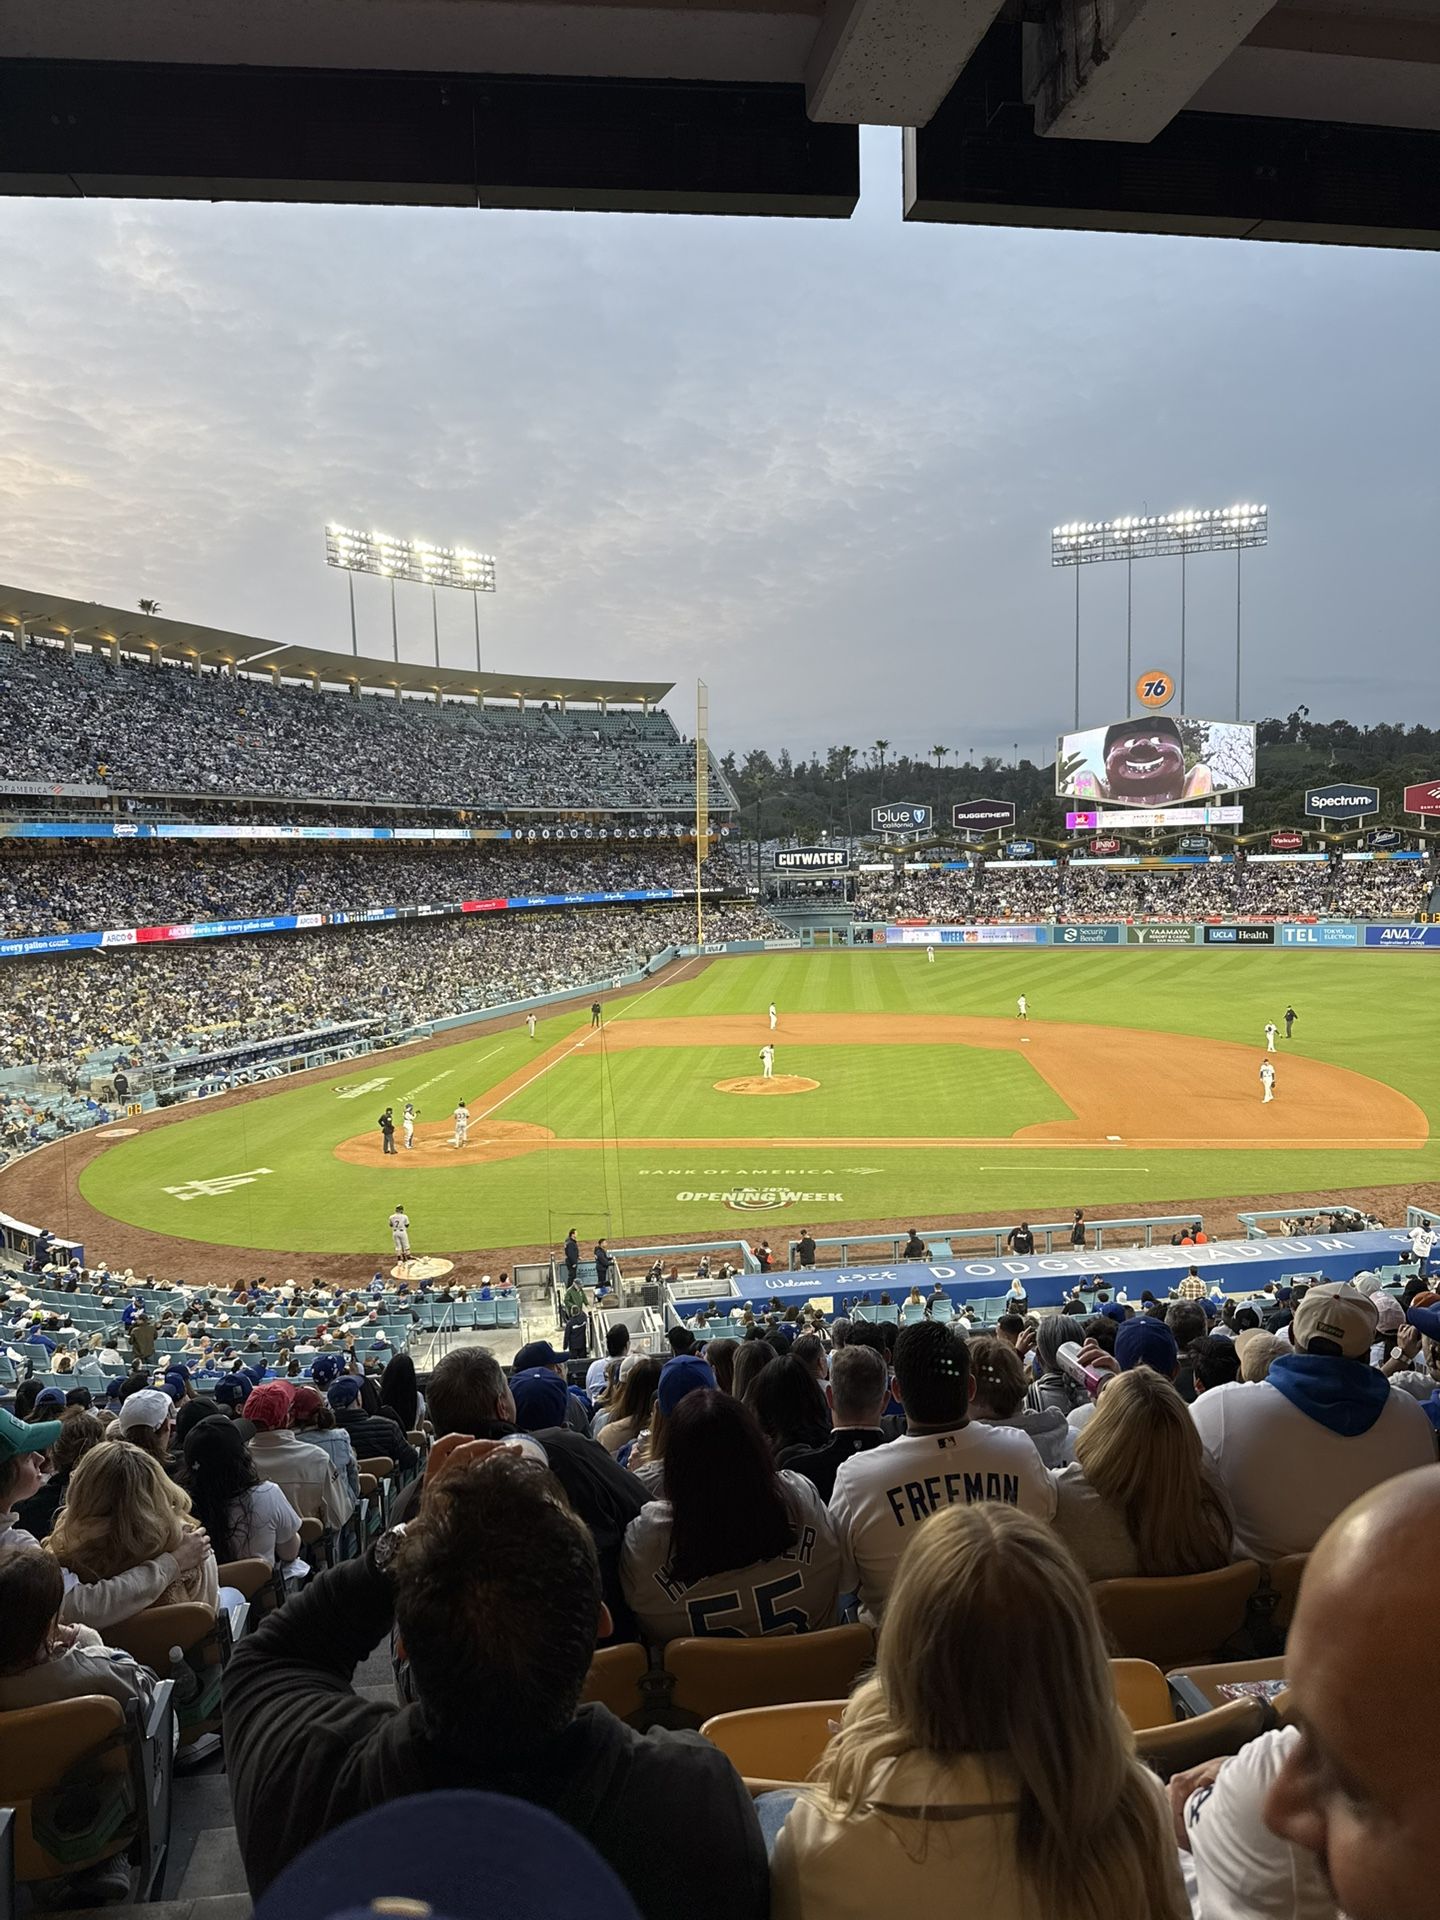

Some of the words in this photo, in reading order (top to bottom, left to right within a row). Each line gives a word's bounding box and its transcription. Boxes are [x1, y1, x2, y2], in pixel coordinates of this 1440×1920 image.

[1143, 678, 1167, 698] 76
[1311, 796, 1369, 809] Spectrum
[878, 809, 910, 822] blue
[958, 811, 1010, 819] GUGGENHEIM
[1096, 840, 1115, 849] JINRO
[779, 853, 843, 865] CUTWATER
[107, 933, 126, 943] ARCO
[940, 931, 965, 943] WEEK
[966, 931, 978, 943] 25
[1080, 928, 1107, 936] Security
[1213, 931, 1233, 939] UCLA
[1239, 930, 1269, 940] Health
[1285, 928, 1318, 942] TEL
[1380, 928, 1410, 939] ANA
[1, 944, 22, 952] every
[24, 942, 48, 952] gallon
[676, 1191, 776, 1202] OPENING
[779, 1191, 845, 1202] WEEK
[1420, 1234, 1431, 1245] 50
[1150, 1238, 1356, 1264] STADIUM
[928, 1254, 1131, 1279] DODGER
[837, 1271, 897, 1284] ようこそ
[765, 1278, 823, 1290] Welcome
[886, 1472, 1019, 1527] FREEMAN
